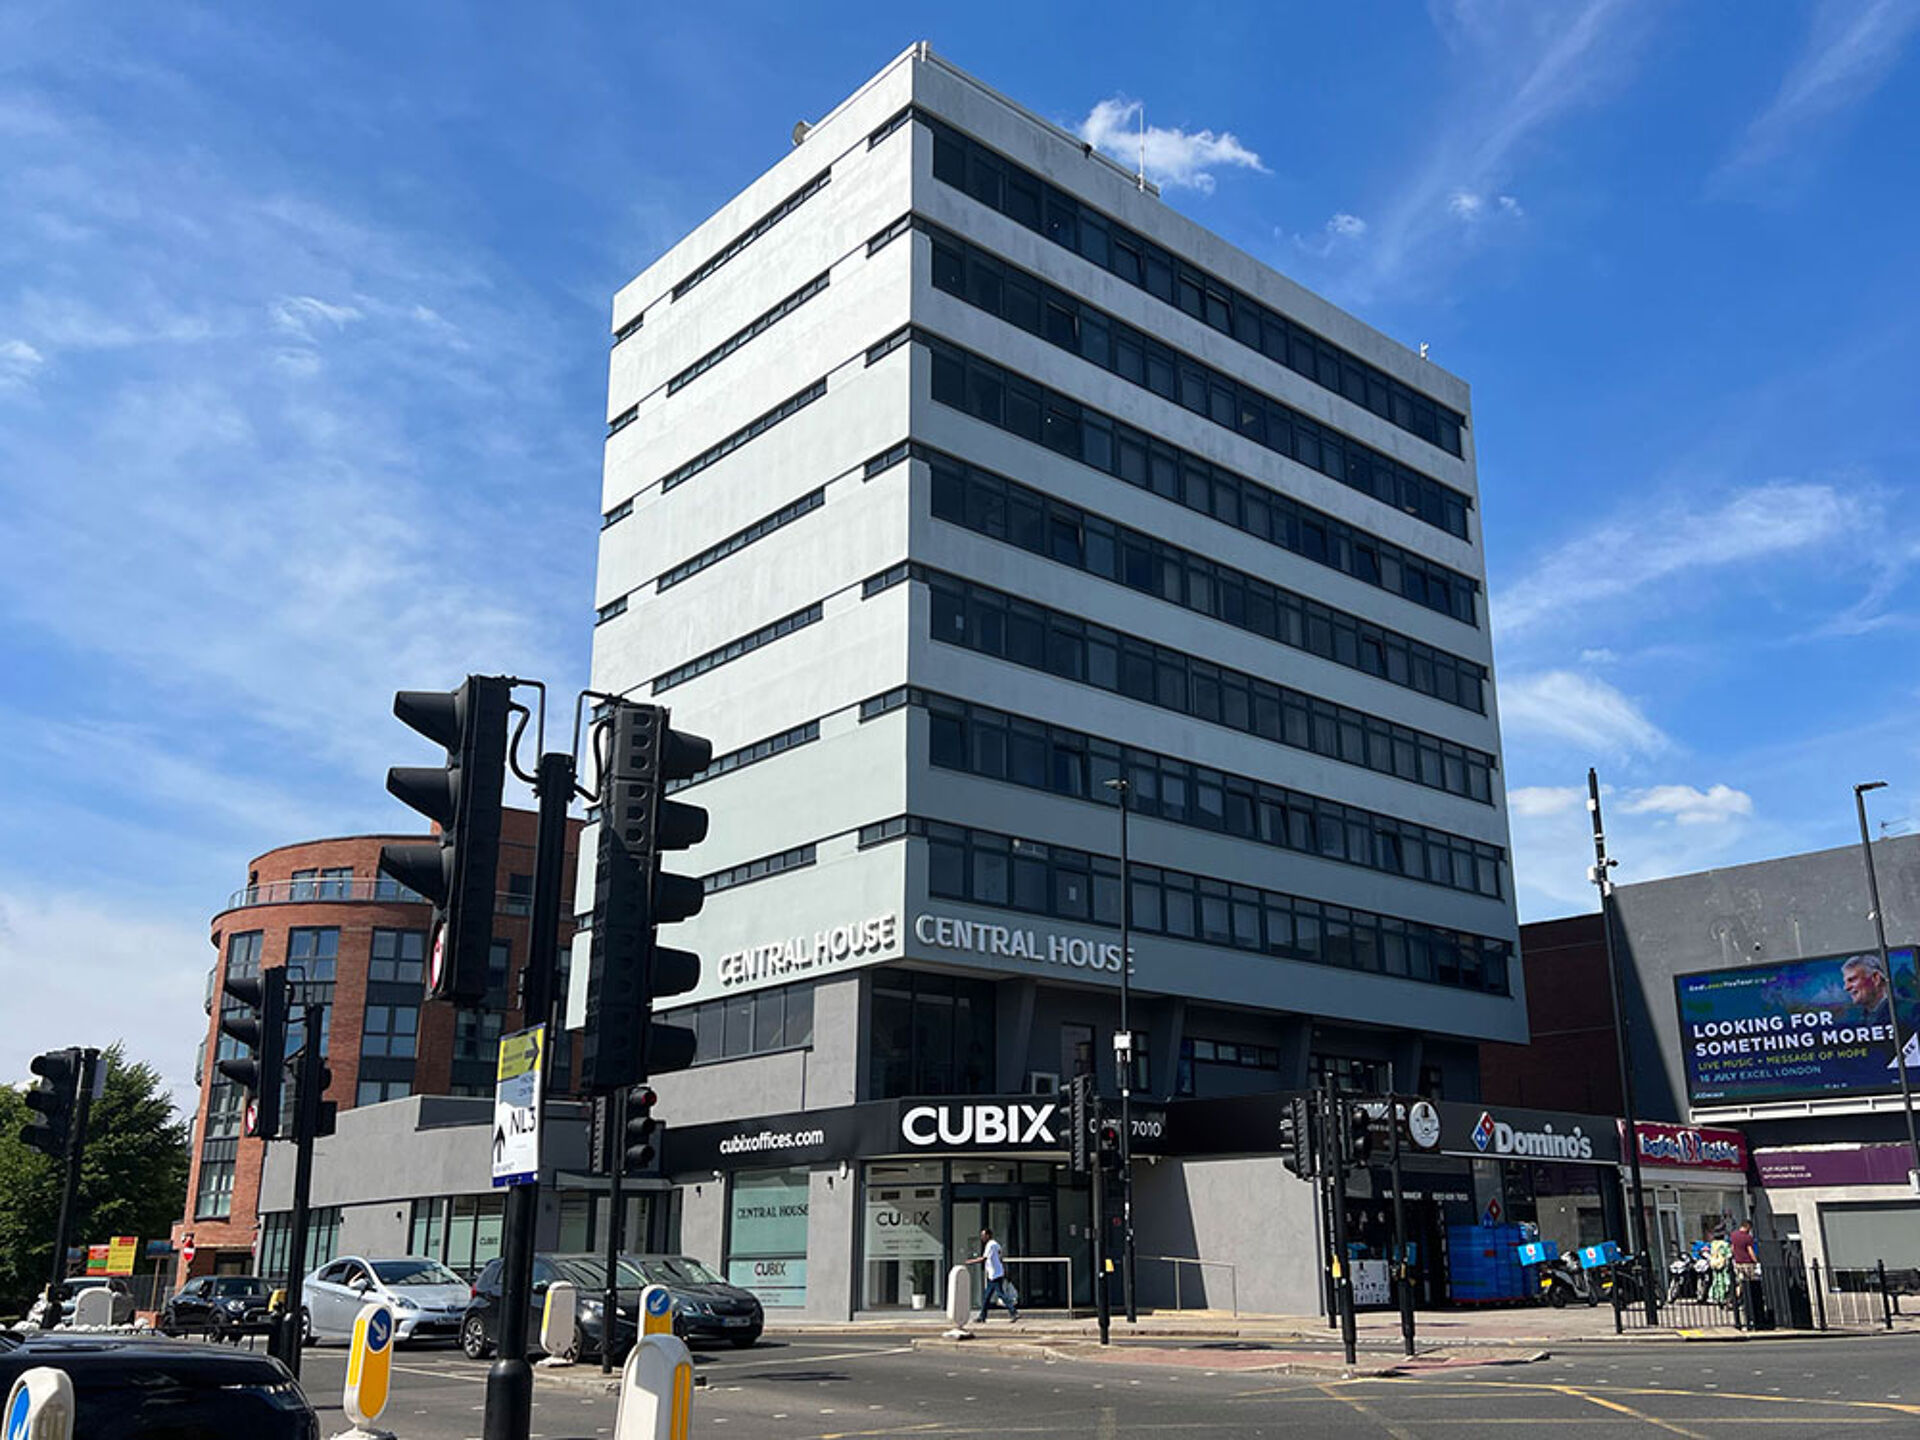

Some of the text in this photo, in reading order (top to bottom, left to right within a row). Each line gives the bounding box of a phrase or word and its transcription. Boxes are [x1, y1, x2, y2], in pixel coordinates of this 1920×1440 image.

[718, 914, 896, 986] CENTRAL HOUSE
[915, 914, 1136, 974] CENTRAL HOUSE
[1693, 1010, 1833, 1038] LOOKING FOR
[1695, 1024, 1894, 1057] SOMETHING MORE?
[1698, 1060, 1720, 1071] LIVE
[1723, 1057, 1754, 1068] MUSIC
[1766, 1052, 1814, 1065] MESSAGE
[1819, 1051, 1833, 1061] OF
[1775, 1064, 1821, 1077] LONDON
[510, 1106, 536, 1136] NL3
[901, 1104, 1056, 1146] CUBIX
[1130, 1121, 1162, 1137] 7010
[720, 1129, 824, 1155] cubixoffices.com
[1495, 1123, 1592, 1159] Domino's
